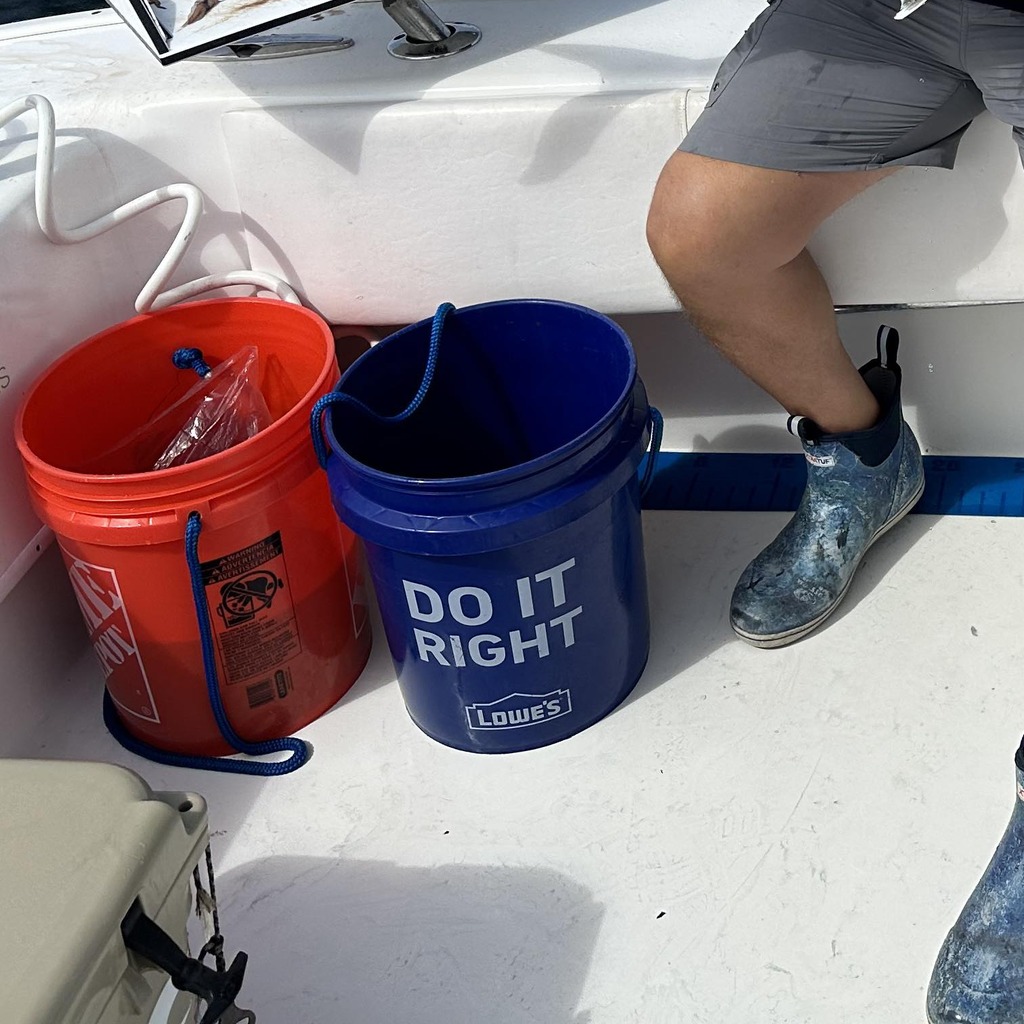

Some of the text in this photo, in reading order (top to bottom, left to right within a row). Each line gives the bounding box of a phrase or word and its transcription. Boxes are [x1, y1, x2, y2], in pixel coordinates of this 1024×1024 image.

[226, 541, 266, 562] WARNING
[402, 557, 576, 626] DO IT
[413, 605, 583, 667] RIGHT
[477, 698, 561, 726] LOWE'S
